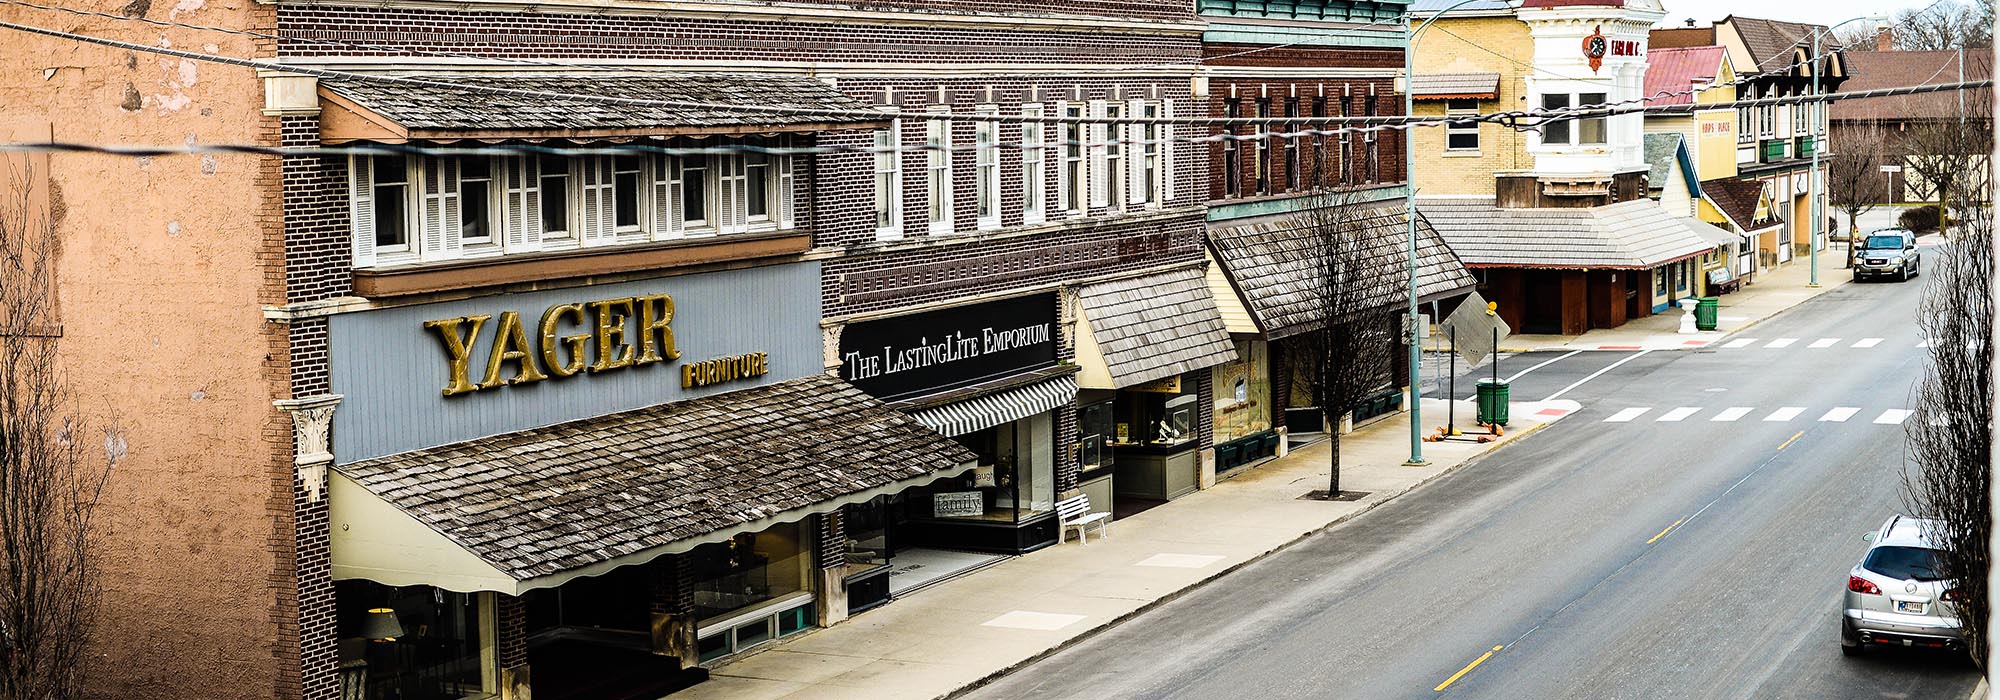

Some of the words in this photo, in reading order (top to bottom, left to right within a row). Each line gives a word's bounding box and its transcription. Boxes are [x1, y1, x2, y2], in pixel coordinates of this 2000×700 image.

[423, 293, 683, 397] YAGER
[682, 352, 770, 389] FURNITURE
[936, 495, 981, 514] family
